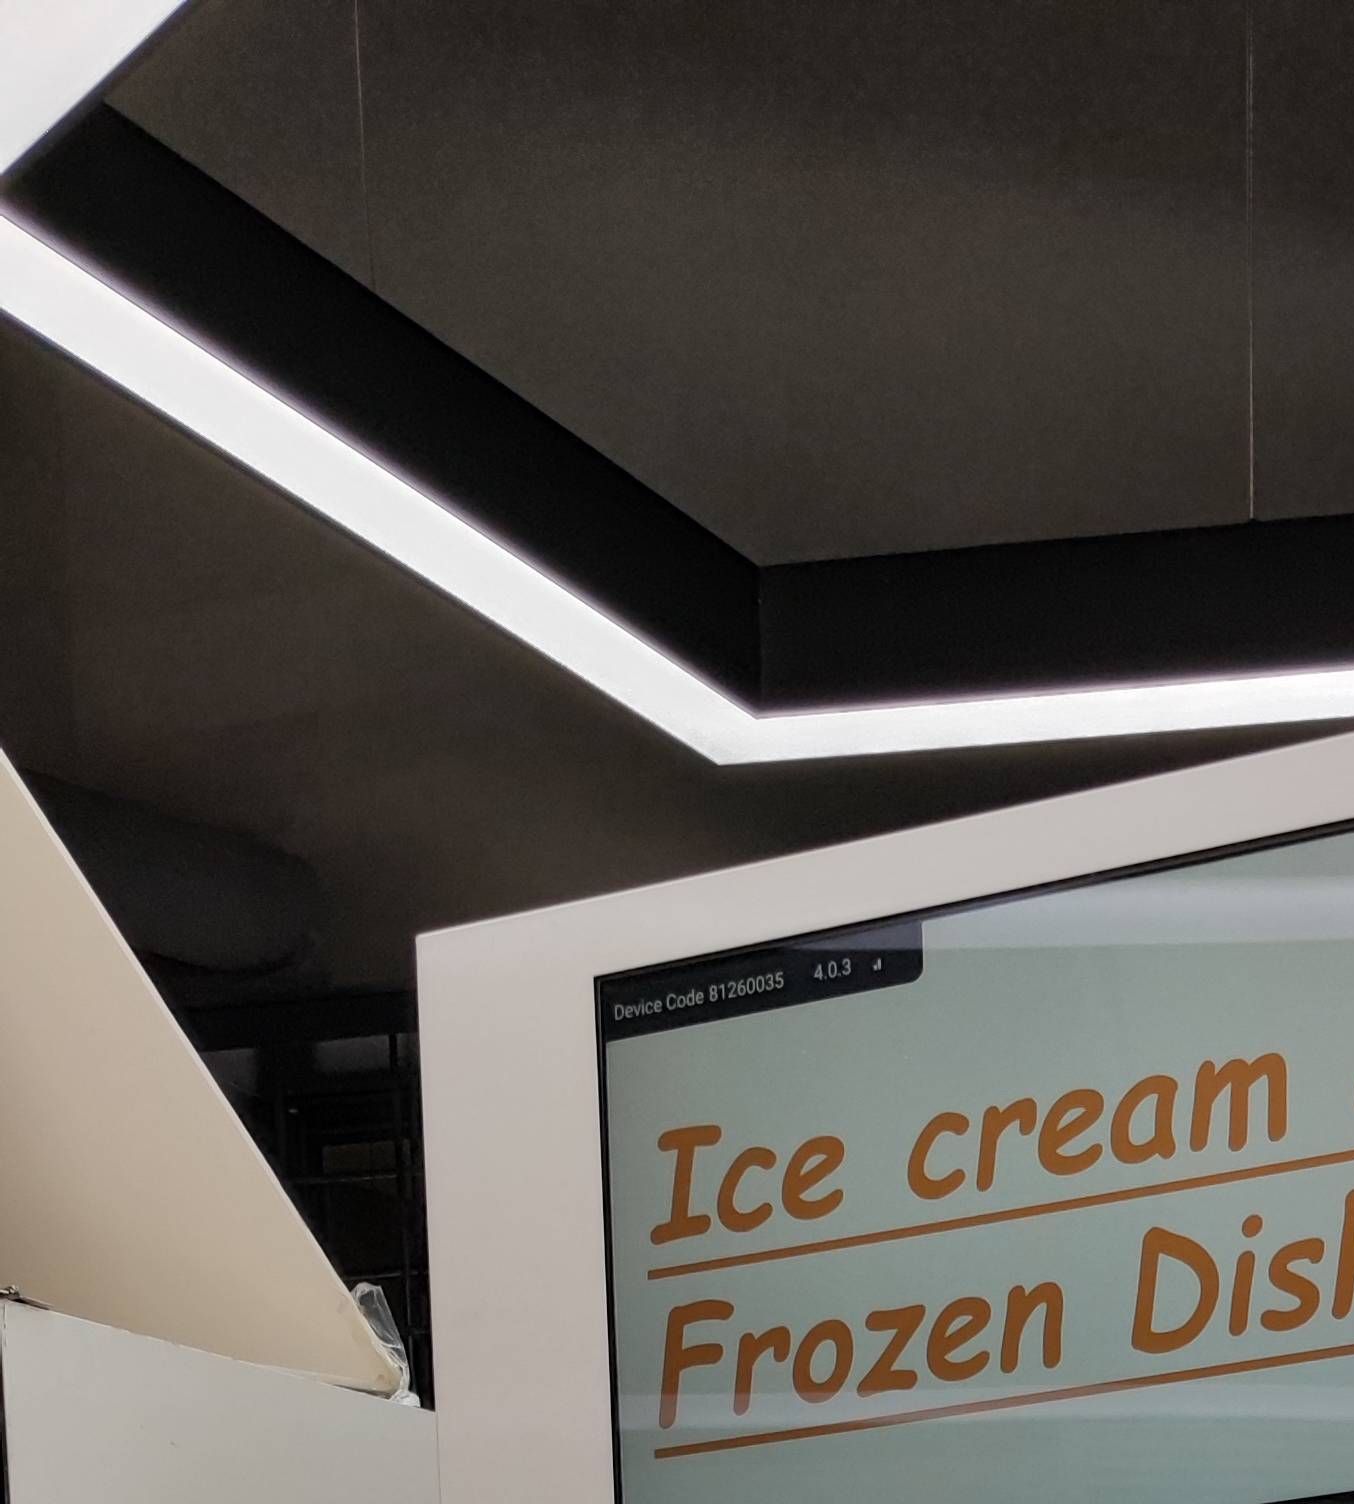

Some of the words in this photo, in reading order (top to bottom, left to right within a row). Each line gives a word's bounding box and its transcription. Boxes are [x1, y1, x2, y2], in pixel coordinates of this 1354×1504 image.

[614, 999, 662, 1021] Device
[666, 990, 704, 1011] Code
[709, 972, 785, 1003] 81260035
[813, 958, 852, 981] 4.0.3
[650, 1124, 845, 1244] Ice
[908, 1053, 1288, 1200] cream
[660, 1282, 1064, 1430] Frozen
